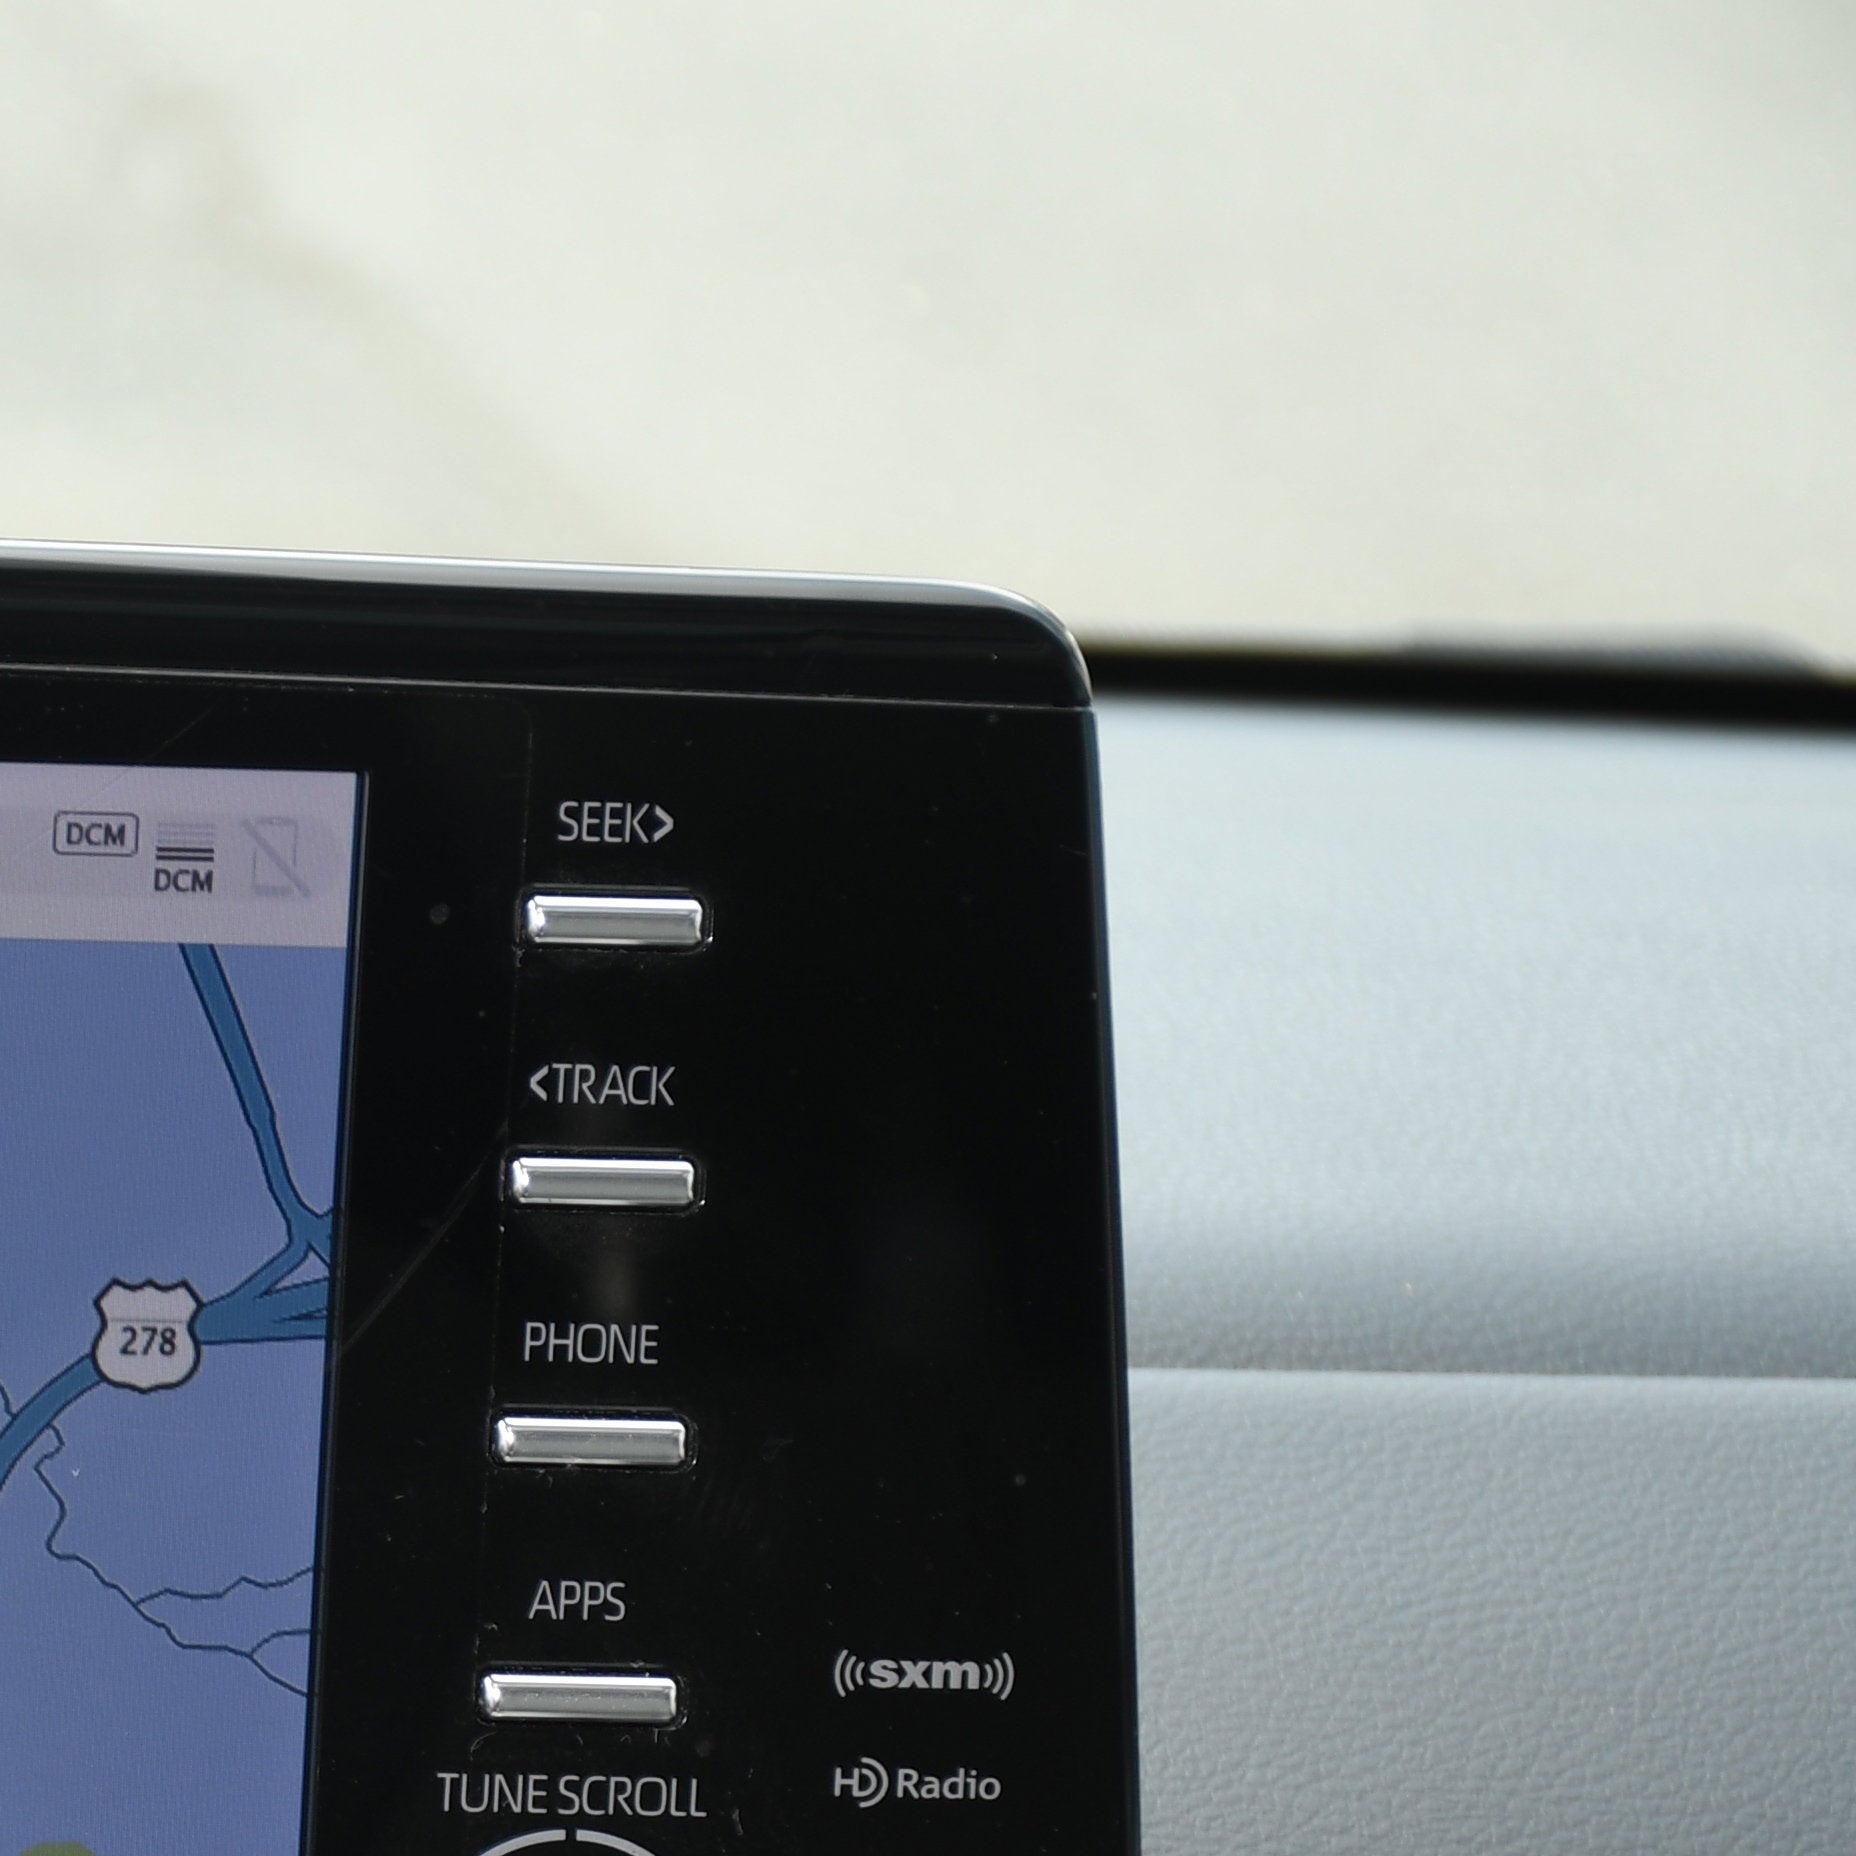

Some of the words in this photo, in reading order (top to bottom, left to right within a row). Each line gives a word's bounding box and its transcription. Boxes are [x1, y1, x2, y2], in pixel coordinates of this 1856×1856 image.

[67, 823, 125, 845] DCM
[155, 868, 213, 893] DCM
[120, 1326, 176, 1356] 278
[525, 1322, 658, 1364] PHONE
[529, 1581, 625, 1621] APPS
[437, 1773, 548, 1813] TUNE
[558, 1775, 706, 1817] SCROLL
[897, 1768, 1000, 1799] Radio
